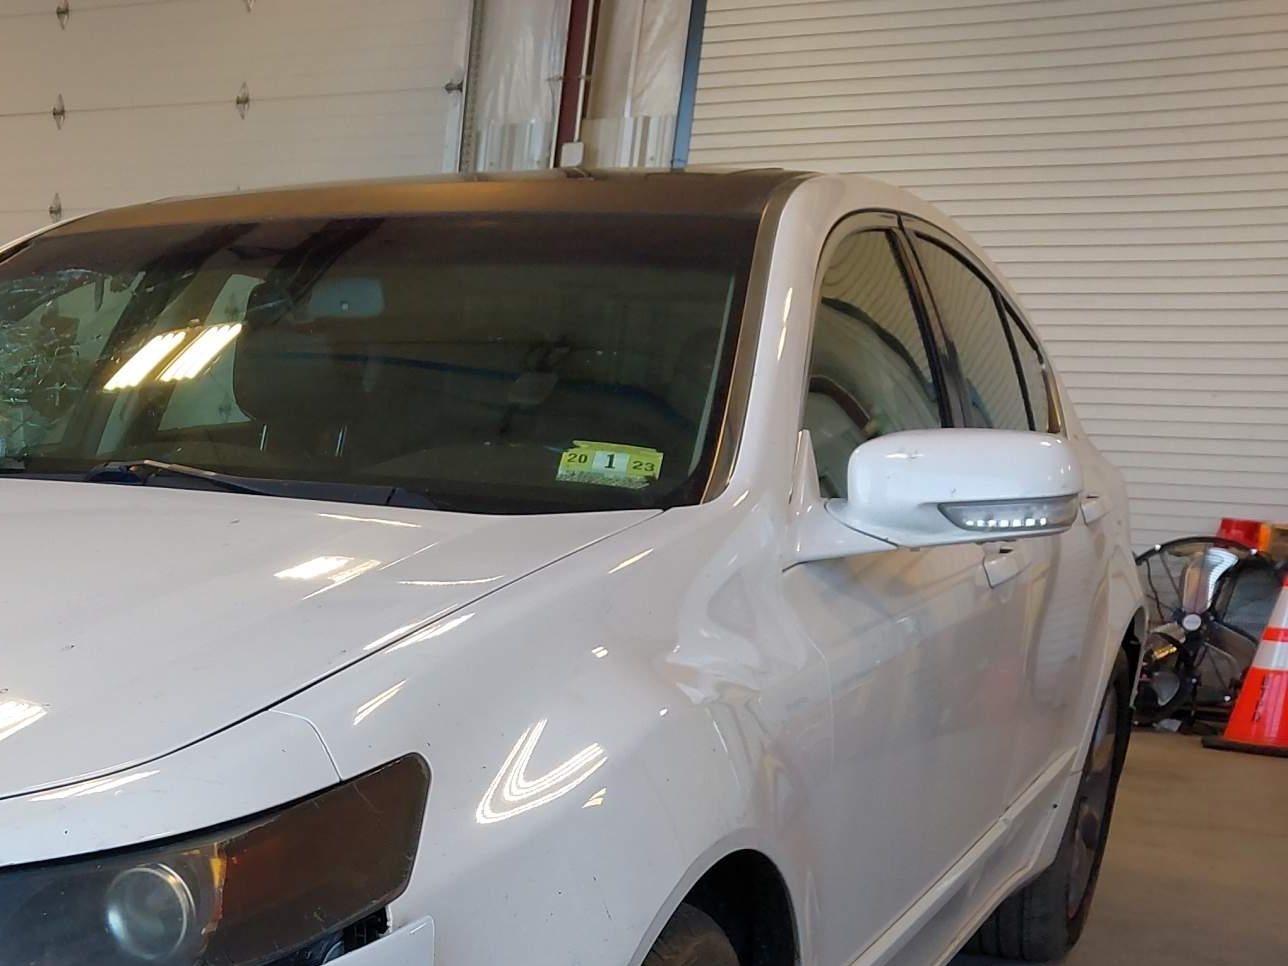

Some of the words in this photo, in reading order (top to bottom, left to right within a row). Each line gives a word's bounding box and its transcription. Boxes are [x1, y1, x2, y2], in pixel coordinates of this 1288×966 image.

[567, 453, 588, 464] 20
[604, 453, 616, 470] 1
[632, 460, 655, 472] 23
